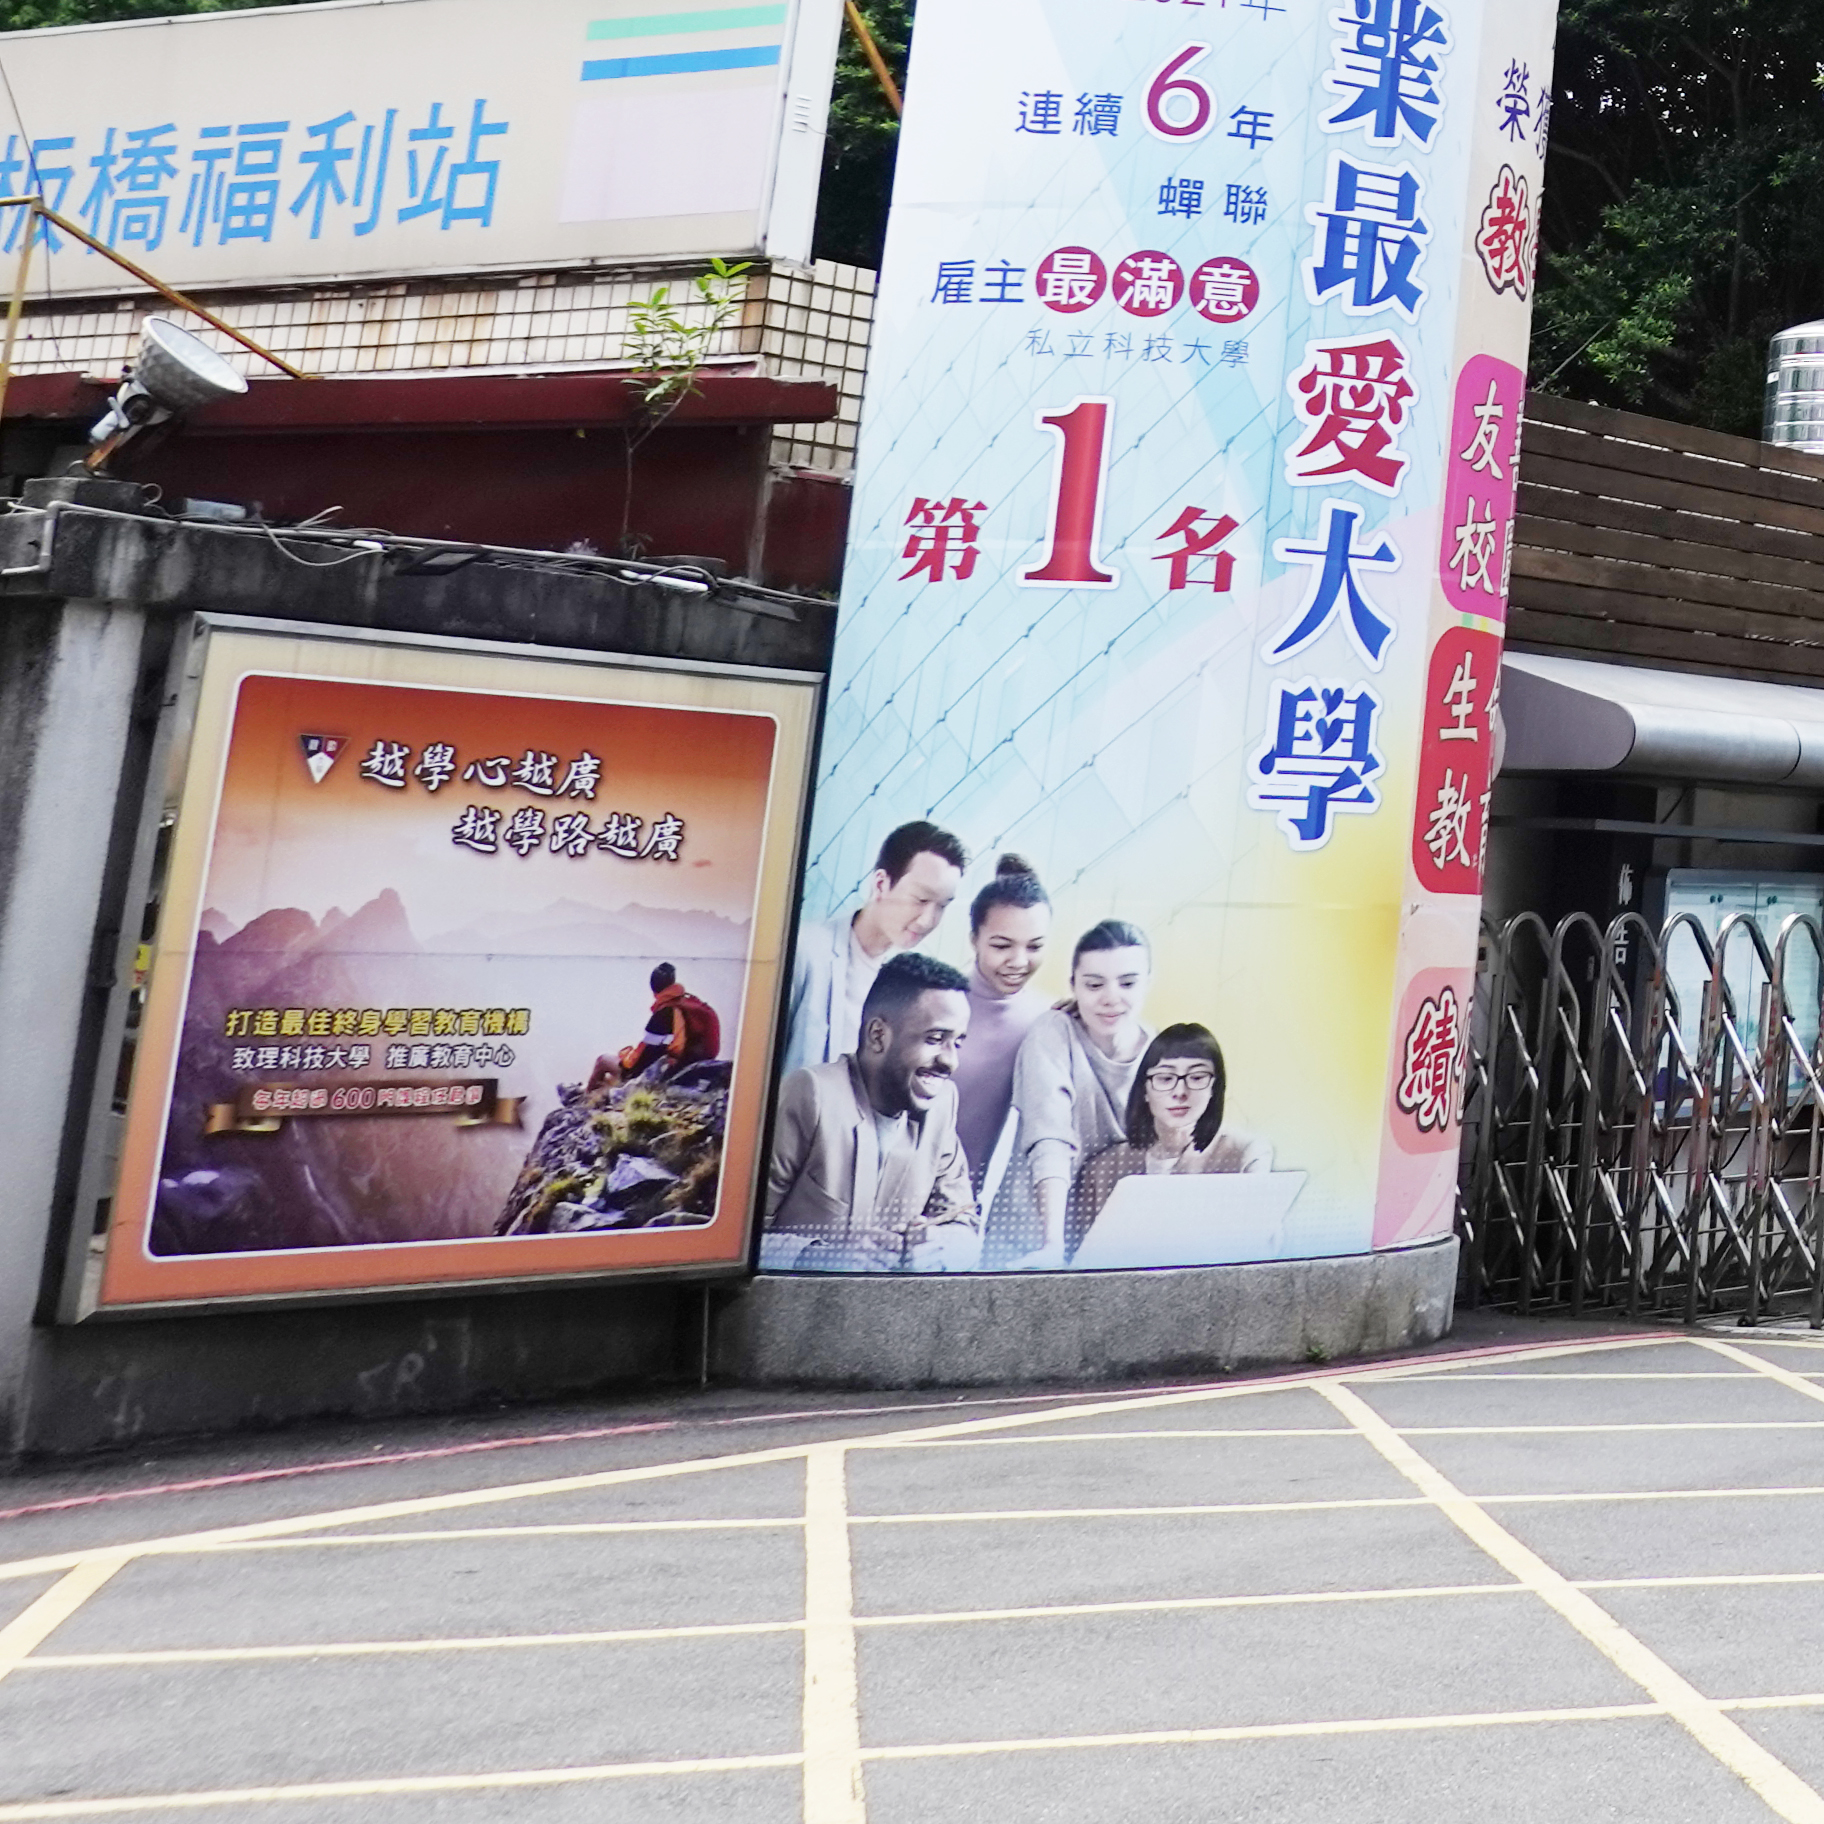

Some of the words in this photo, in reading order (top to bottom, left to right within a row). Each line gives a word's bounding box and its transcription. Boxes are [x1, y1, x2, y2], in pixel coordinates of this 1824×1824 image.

[1014, 44, 1276, 150] 連續6年
[0, 97, 509, 255] 板橋福利站
[1156, 176, 1269, 226] 蟬聯
[929, 250, 1256, 319] 雇主最滿意
[1025, 327, 1250, 369] 私立科技大學
[897, 402, 1240, 594] 第1名
[360, 739, 602, 800] 越學心越廣
[452, 805, 686, 862] 越學路越廣
[225, 1008, 531, 1037] 打造最佳終身學習教育機構
[231, 1044, 372, 1071] 致理科技大學
[385, 1043, 516, 1069] 推廣教育中心
